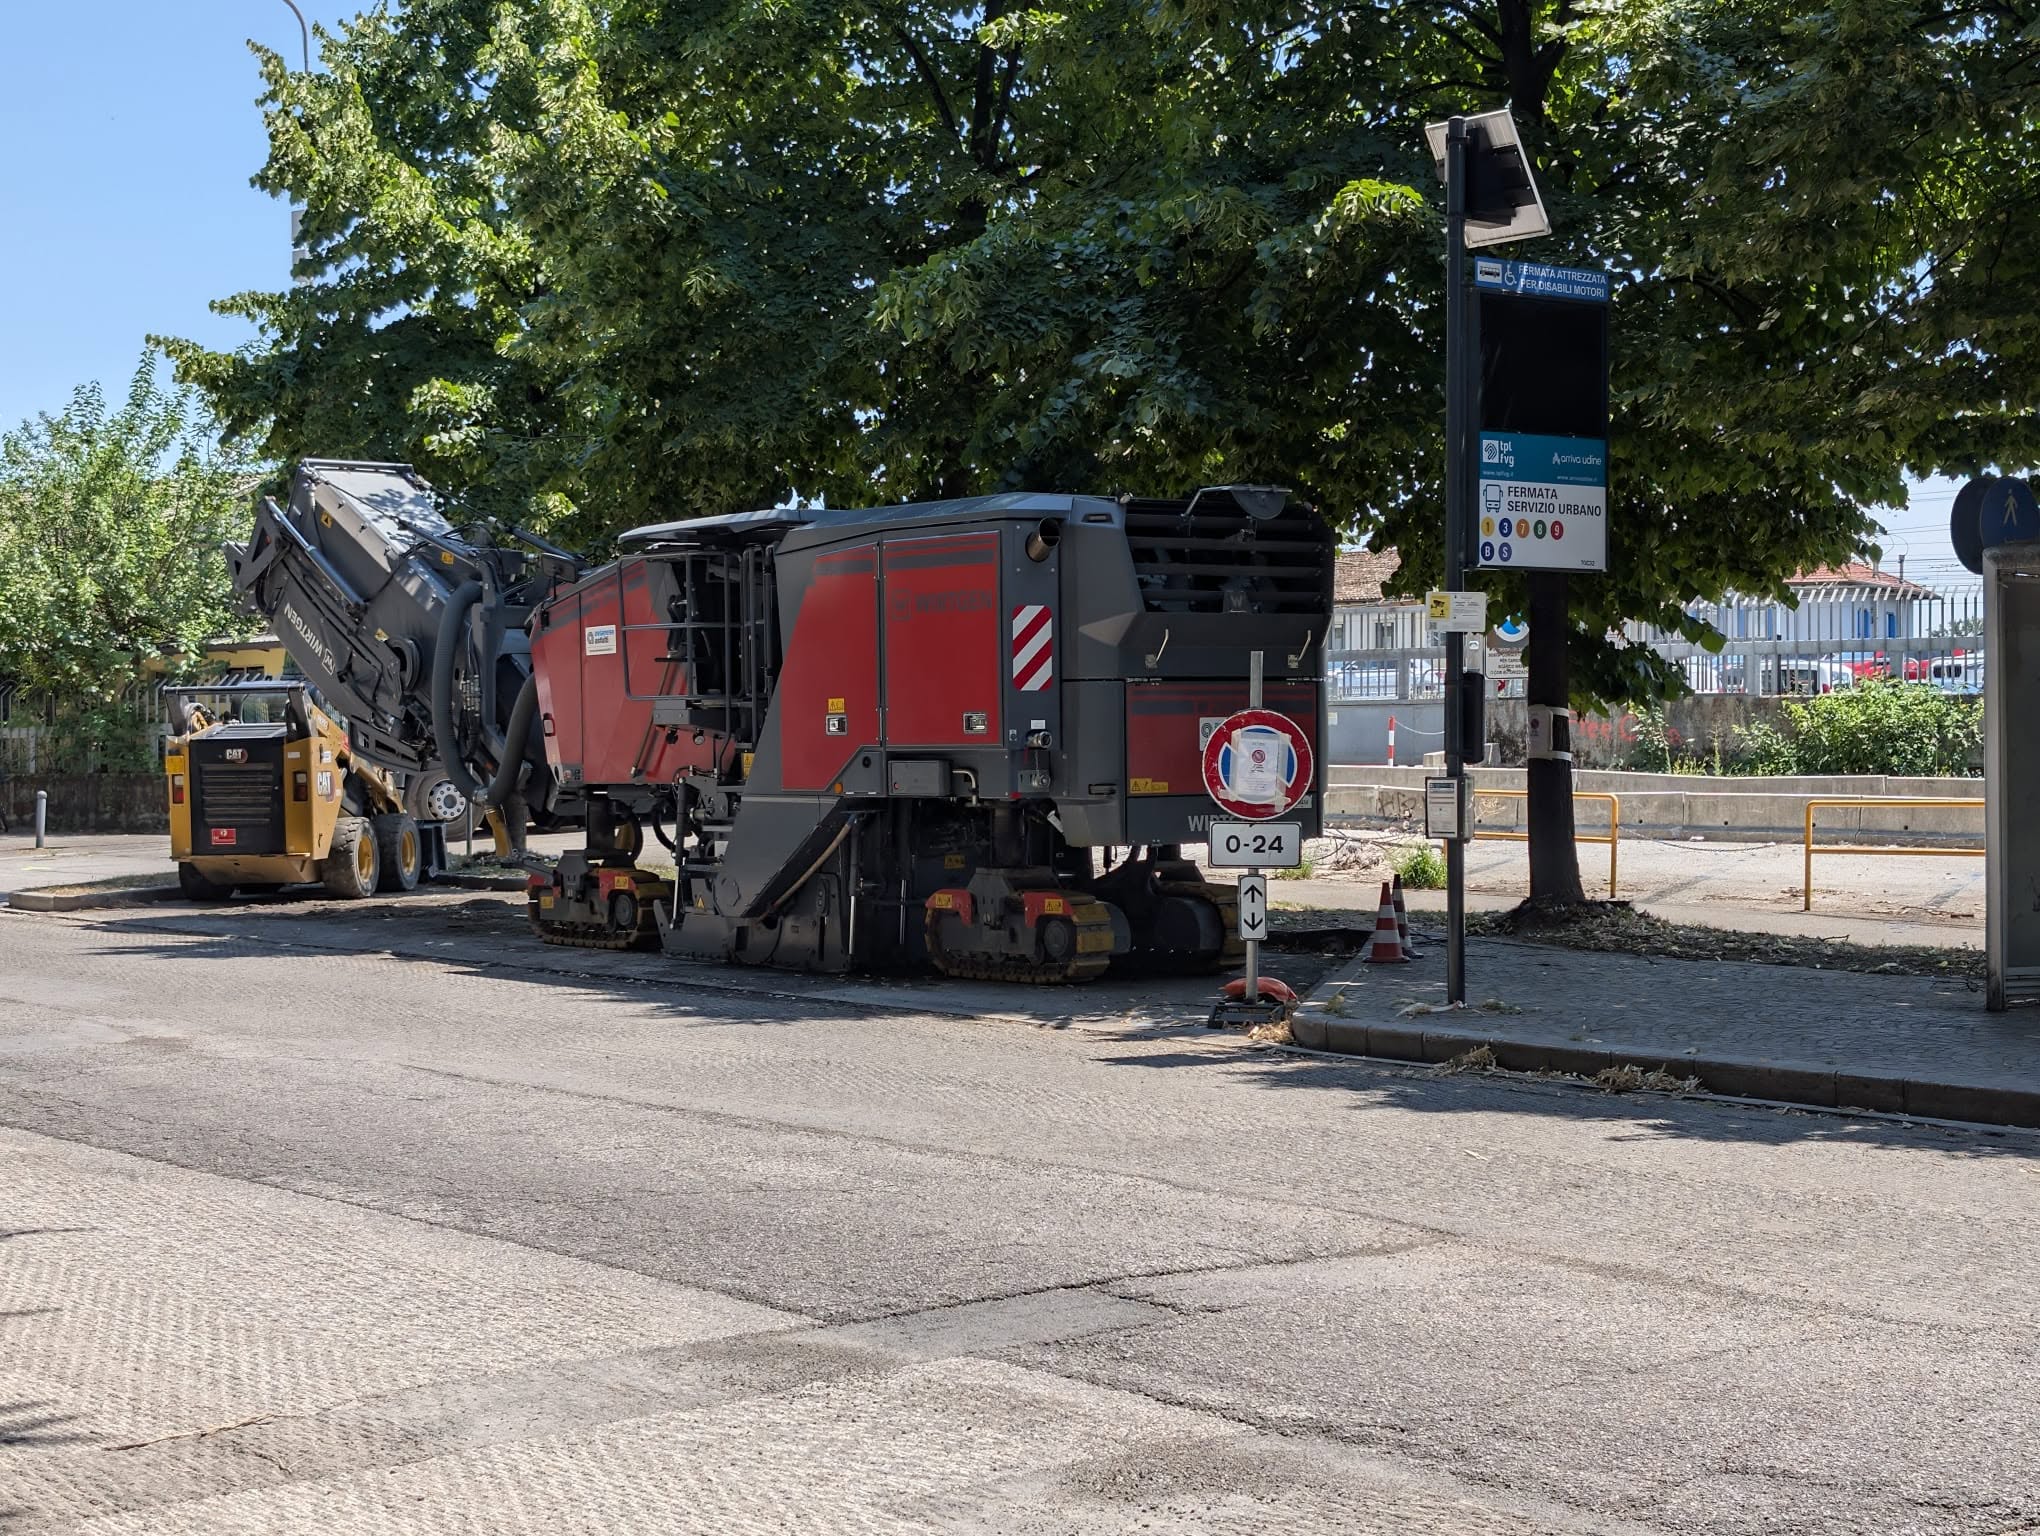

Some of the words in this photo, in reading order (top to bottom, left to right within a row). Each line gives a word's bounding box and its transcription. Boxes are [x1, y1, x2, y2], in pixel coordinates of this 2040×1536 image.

[1518, 264, 1556, 279] FERMATA
[1557, 269, 1606, 284] ATTREZZATA
[1520, 279, 1537, 289] PER
[1539, 281, 1572, 294] DISABILI
[1573, 286, 1604, 297] MOTORI
[1500, 440, 1513, 454] tpl
[1500, 454, 1514, 467] fvg
[1582, 454, 1602, 465] udine
[1507, 486, 1558, 500] FERMATA
[1507, 501, 1555, 514] SERVIZIO
[1558, 503, 1602, 517] URBANO
[284, 602, 323, 657] WIRTGEN
[226, 748, 243, 760] CAT
[317, 771, 332, 796] CAT
[1225, 834, 1284, 854] 0-24
